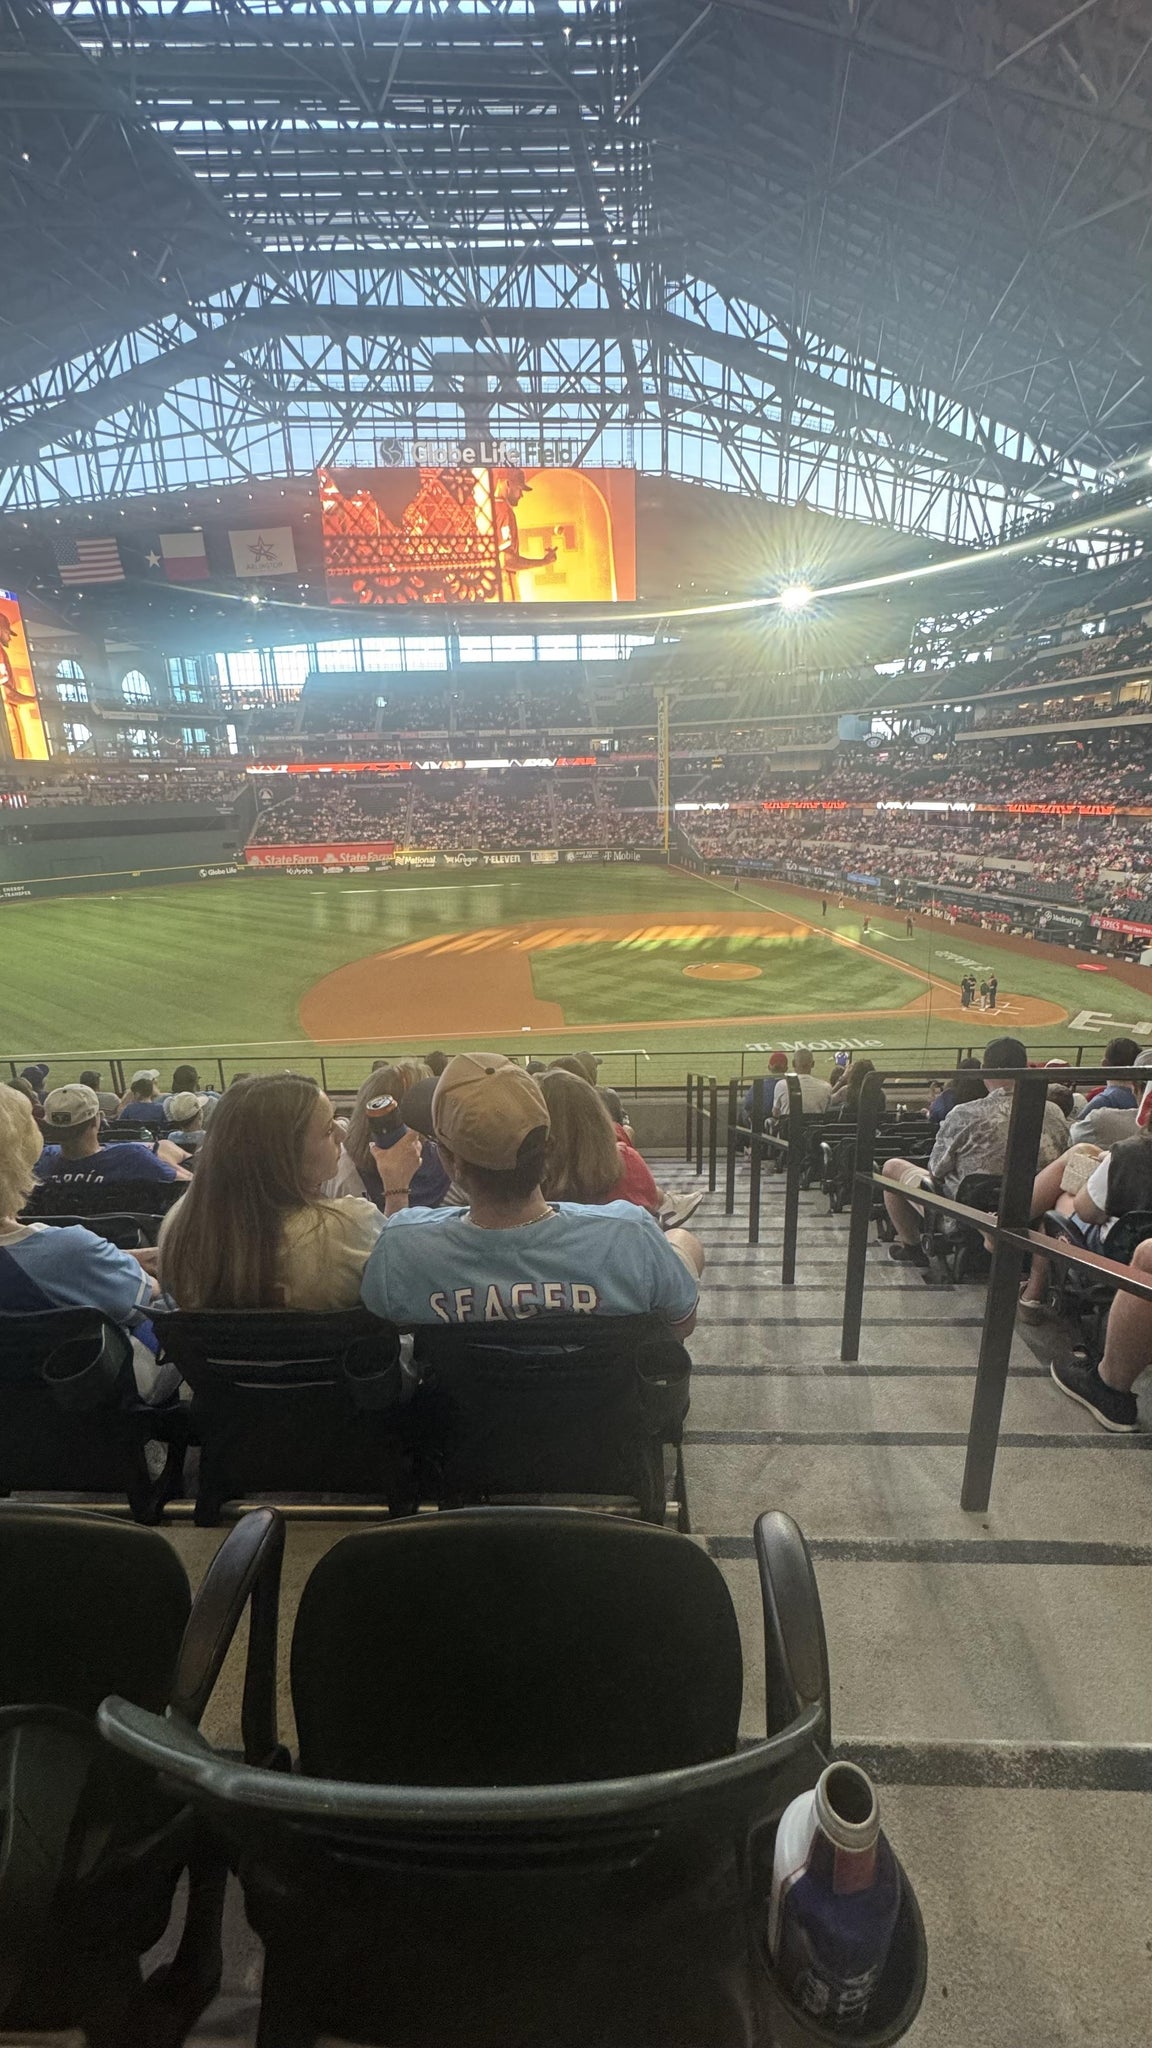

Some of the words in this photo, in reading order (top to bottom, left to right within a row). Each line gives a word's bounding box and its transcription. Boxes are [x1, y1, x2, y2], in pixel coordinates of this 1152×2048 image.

[411, 441, 476, 464] Globe
[481, 441, 520, 464] Life
[525, 441, 573, 464] Field
[404, 856, 436, 865] National
[454, 853, 478, 867] Kroger
[613, 851, 641, 861] Mobile
[207, 869, 225, 877] Globe
[286, 867, 314, 875] Kubota
[4, 890, 32, 898] TRANSFER
[1052, 913, 1072, 924] Medical
[1071, 917, 1083, 928] City
[776, 1038, 885, 1052] Mobile
